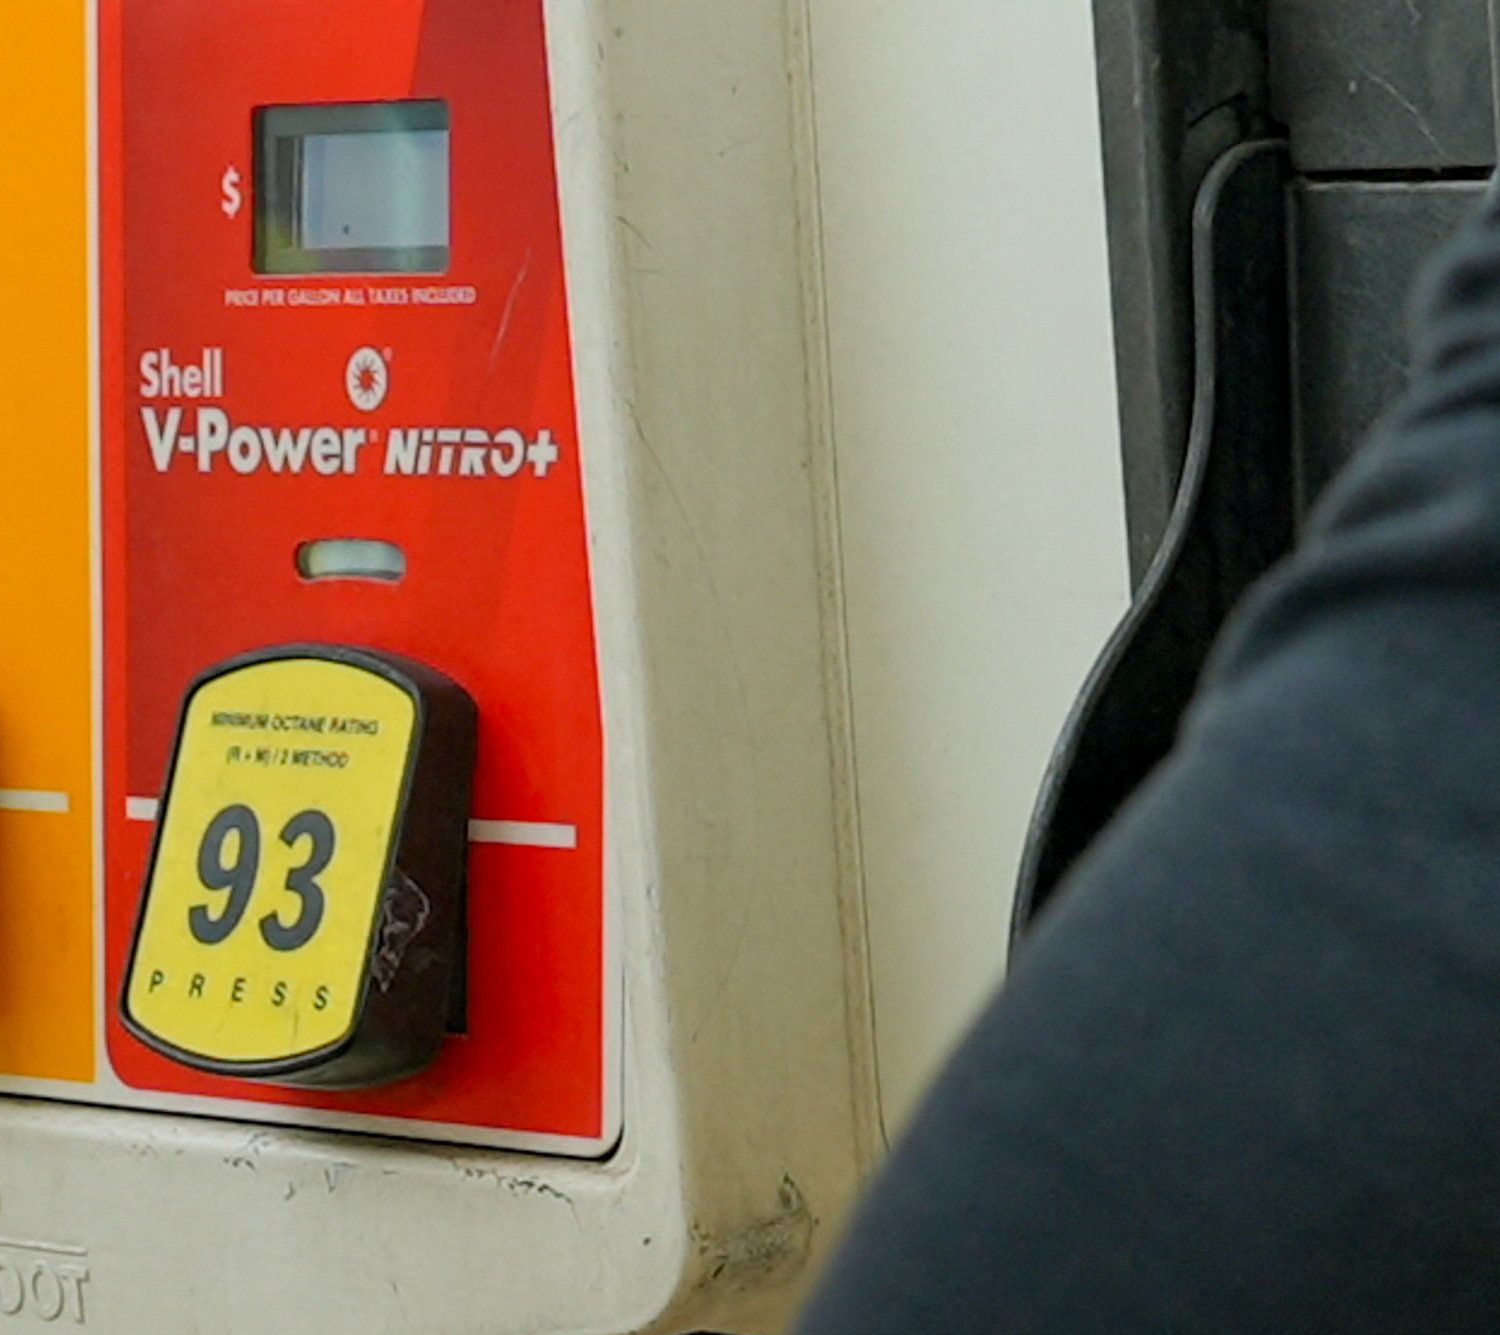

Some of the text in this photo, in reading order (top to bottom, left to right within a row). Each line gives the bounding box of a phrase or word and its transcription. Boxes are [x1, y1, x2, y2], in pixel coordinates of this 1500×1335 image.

[222, 166, 241, 218] $
[140, 347, 222, 398] Shell
[212, 711, 378, 736] MINIMUM OCTANE RATING
[292, 749, 349, 769] METHOD
[187, 803, 336, 952] 93
